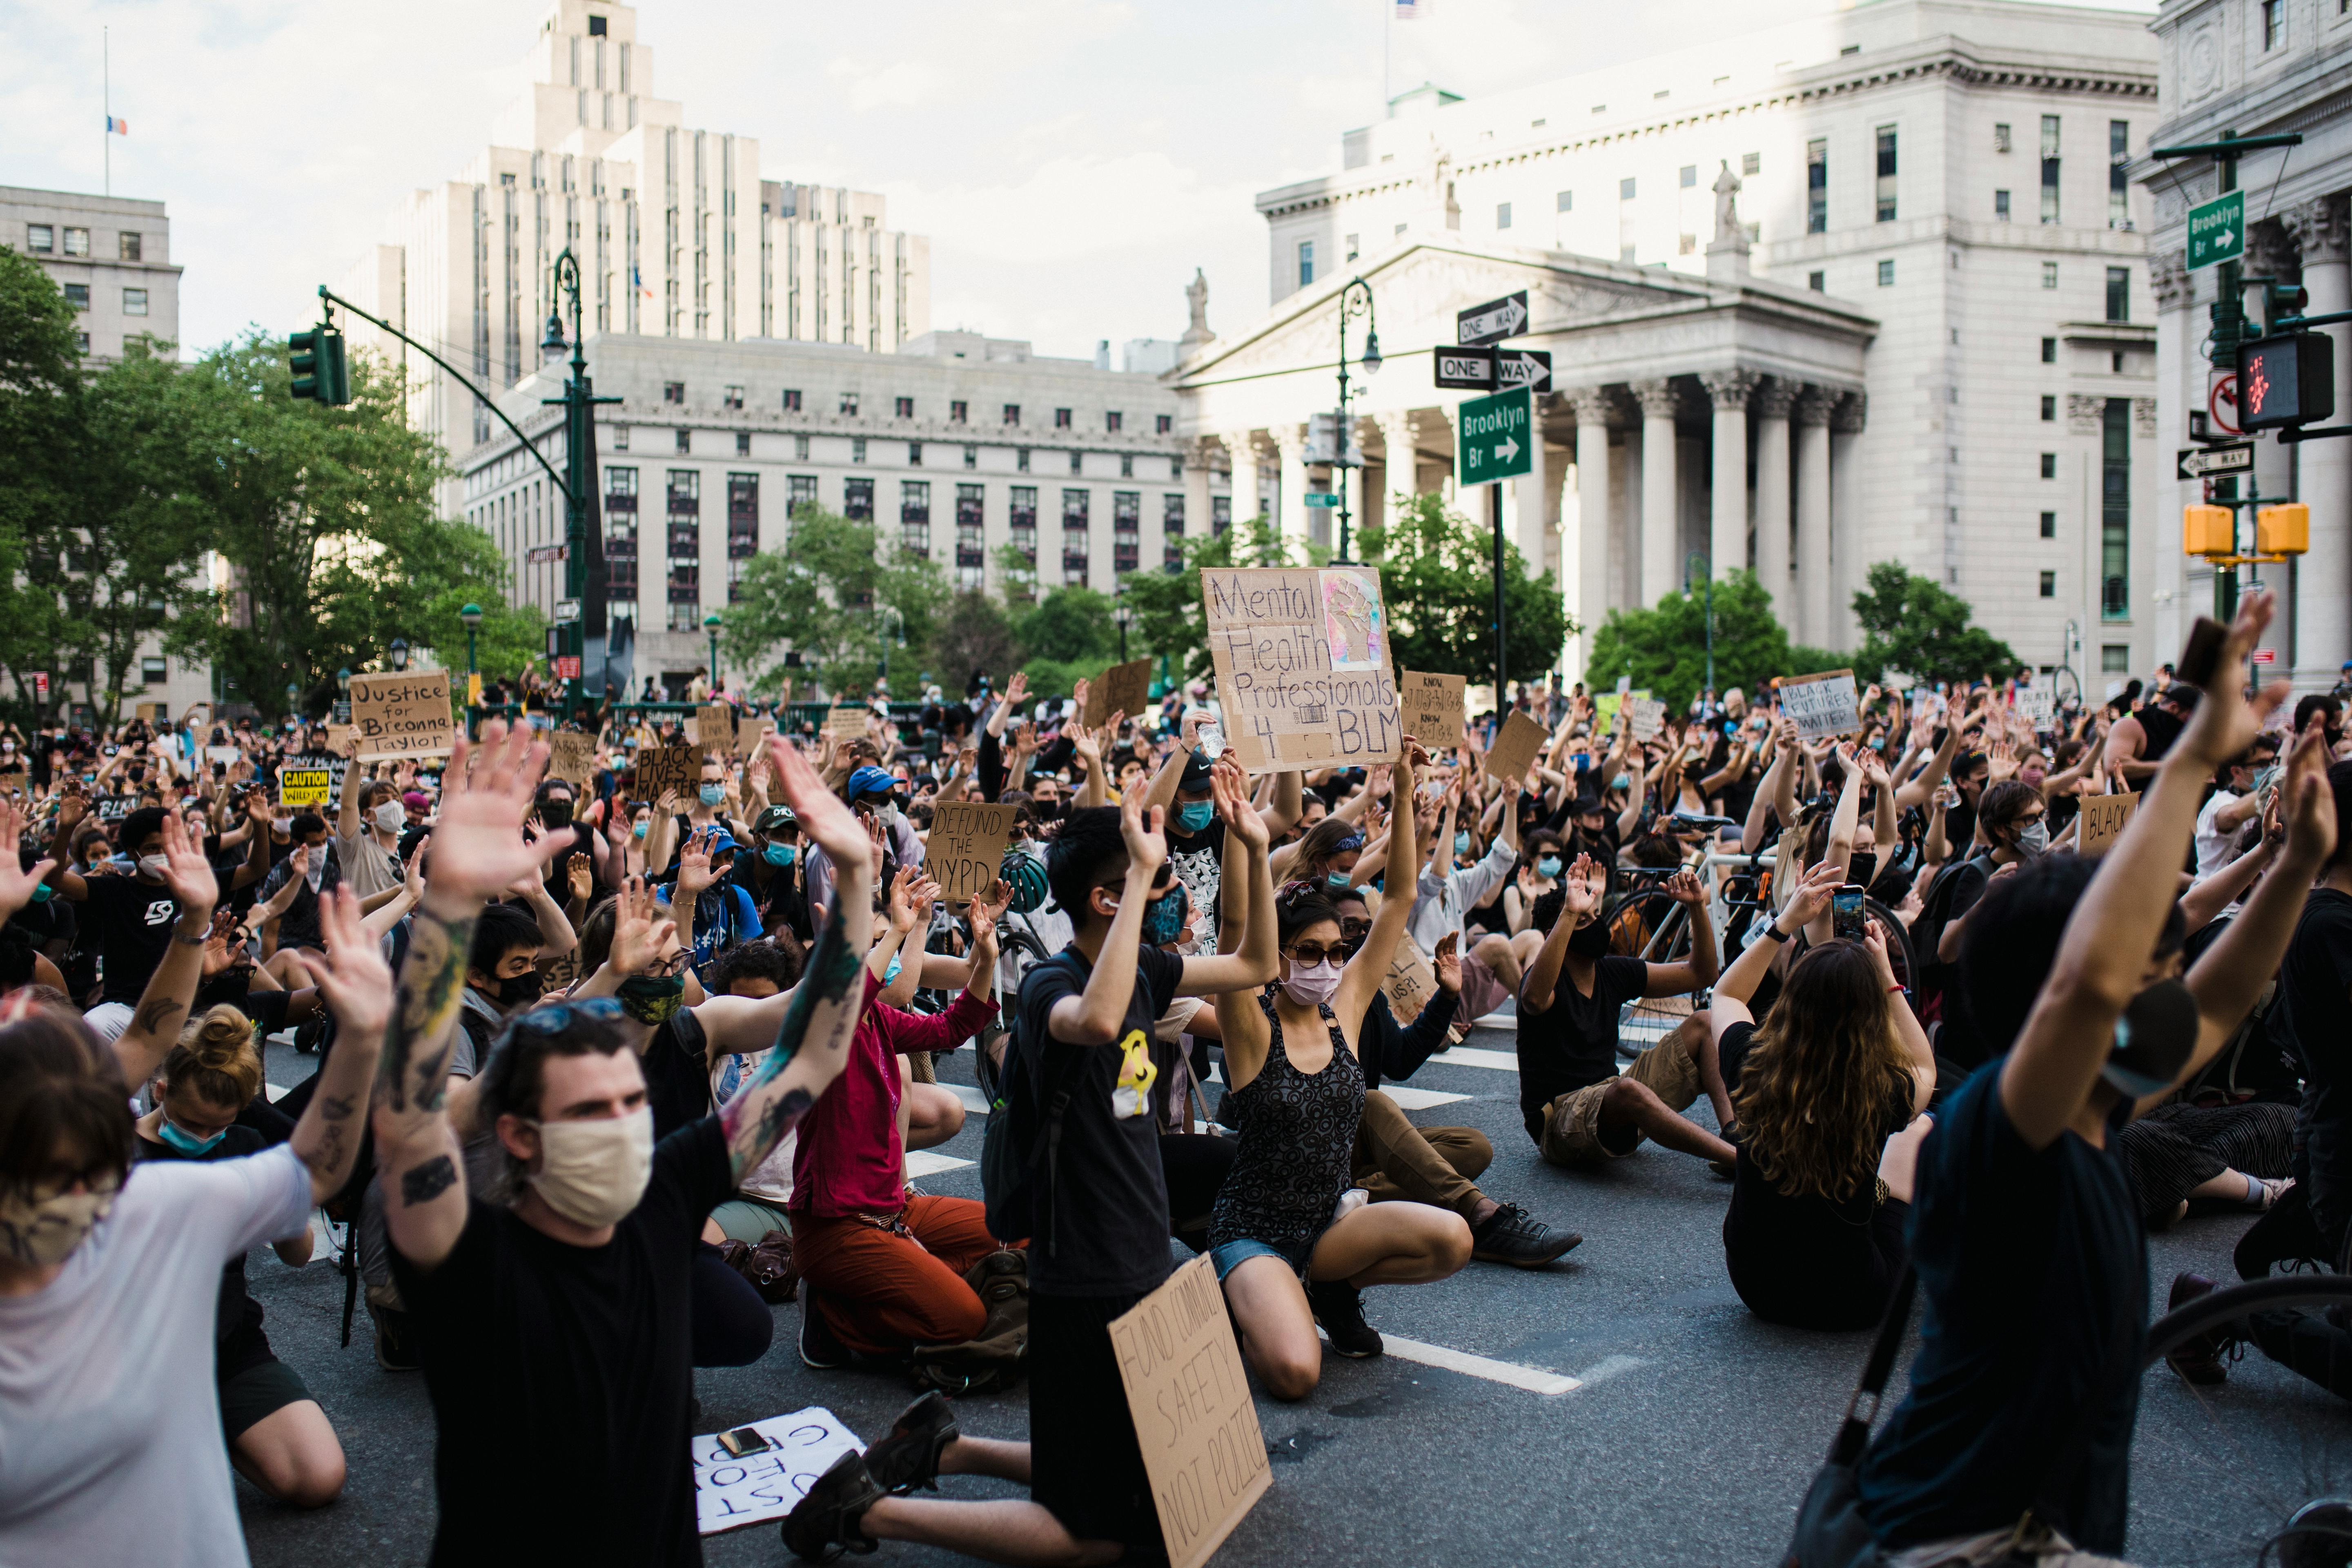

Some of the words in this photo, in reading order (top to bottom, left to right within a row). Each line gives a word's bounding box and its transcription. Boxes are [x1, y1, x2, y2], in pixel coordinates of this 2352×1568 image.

[2192, 205, 2239, 234] Brooklyn
[2195, 241, 2206, 257] Br
[1462, 318, 1483, 338] ONE
[1494, 306, 1518, 327] WAY
[1444, 360, 1479, 377] ONE
[1500, 361, 1536, 379] WAY
[1464, 405, 1524, 437] Brooklyn
[1470, 447, 1483, 468] Br
[2189, 457, 2209, 470] ONE
[2221, 452, 2245, 464] WAY
[1212, 575, 1316, 619] Mental
[1226, 624, 1332, 671] Health
[357, 684, 445, 702] Justice
[1235, 670, 1393, 708] Professionals
[1787, 682, 1831, 699] BLACK
[382, 704, 412, 719] for
[1792, 692, 1850, 715] FUTURES
[362, 717, 450, 736] Breonna
[646, 711, 683, 723] Subway
[1421, 713, 1440, 723] KNOW
[1798, 713, 1847, 729] MATTER
[1254, 715, 1275, 758] 4
[1337, 706, 1403, 754] BLM
[367, 735, 442, 752] Taylor
[554, 739, 593, 756] ABOLISH
[557, 760, 590, 773] NYPD
[640, 748, 694, 767] BLACK
[284, 771, 328, 786] CAUTION
[639, 764, 687, 783] LIVES
[285, 788, 310, 801] WILD
[636, 779, 700, 801] MATTER
[99, 797, 136, 817] BLM
[934, 808, 1001, 836] DEFUND
[2089, 804, 2127, 840] BLACK
[949, 837, 972, 855] THE
[927, 858, 989, 895] NYPD
[1390, 976, 1420, 1000] US?!
[1115, 1304, 1174, 1391] FUND
[1170, 1259, 1224, 1342] COMMUNITY
[1156, 1330, 1236, 1449] SAFETY
[1162, 1457, 1210, 1557] NOT
[1208, 1392, 1267, 1509] POLICE
